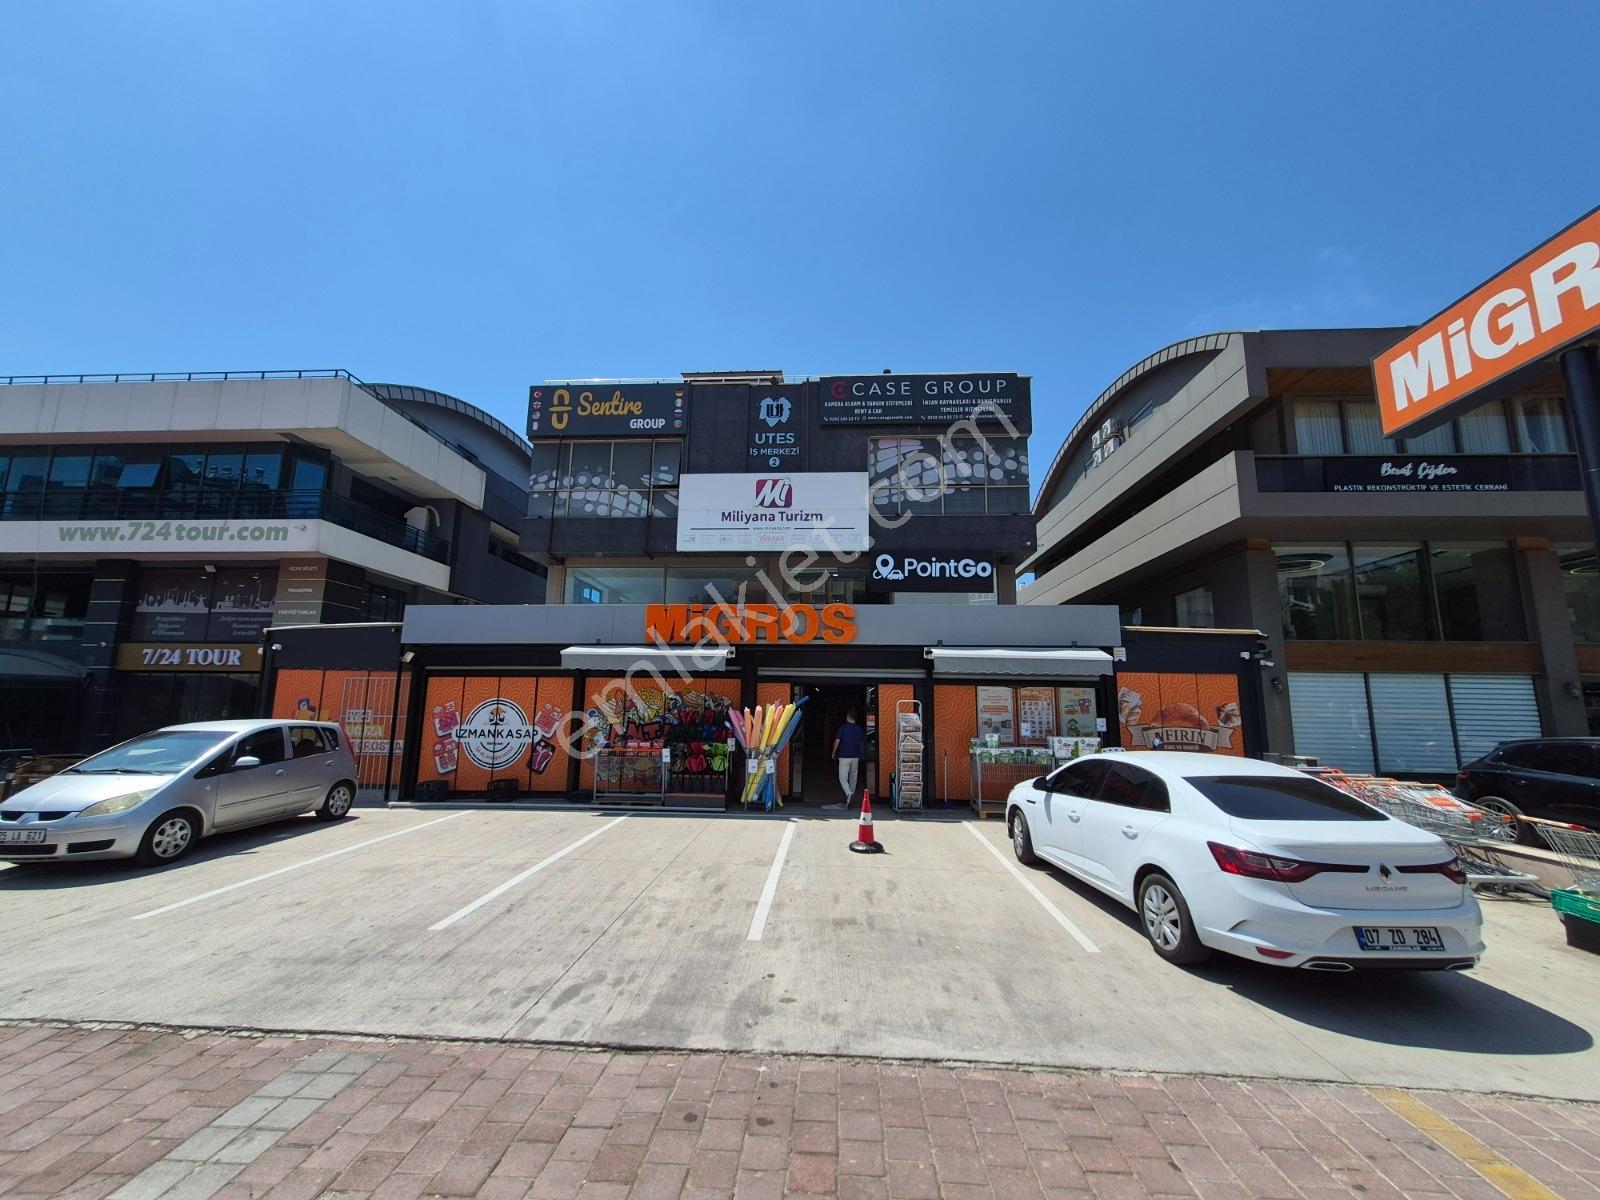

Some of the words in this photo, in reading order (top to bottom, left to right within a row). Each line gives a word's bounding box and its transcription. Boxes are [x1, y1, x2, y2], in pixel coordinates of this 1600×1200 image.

[852, 382, 911, 396] CASE
[924, 379, 1007, 395] GROUP
[577, 390, 643, 417] Sentire
[629, 418, 666, 429] GROUP
[755, 432, 796, 445] UTES
[760, 446, 800, 456] MERKEZİ
[721, 510, 776, 525] Miliyana
[778, 510, 824, 523] Turizm
[58, 521, 289, 542] www.724tour.com
[903, 556, 993, 579] PointGo
[142, 648, 182, 665] 7/24
[186, 648, 242, 666] TOUR
[26, 831, 42, 841] 621
[1364, 929, 1380, 945] 07
[1387, 929, 1406, 945] ZD
[1413, 929, 1438, 945] 284
